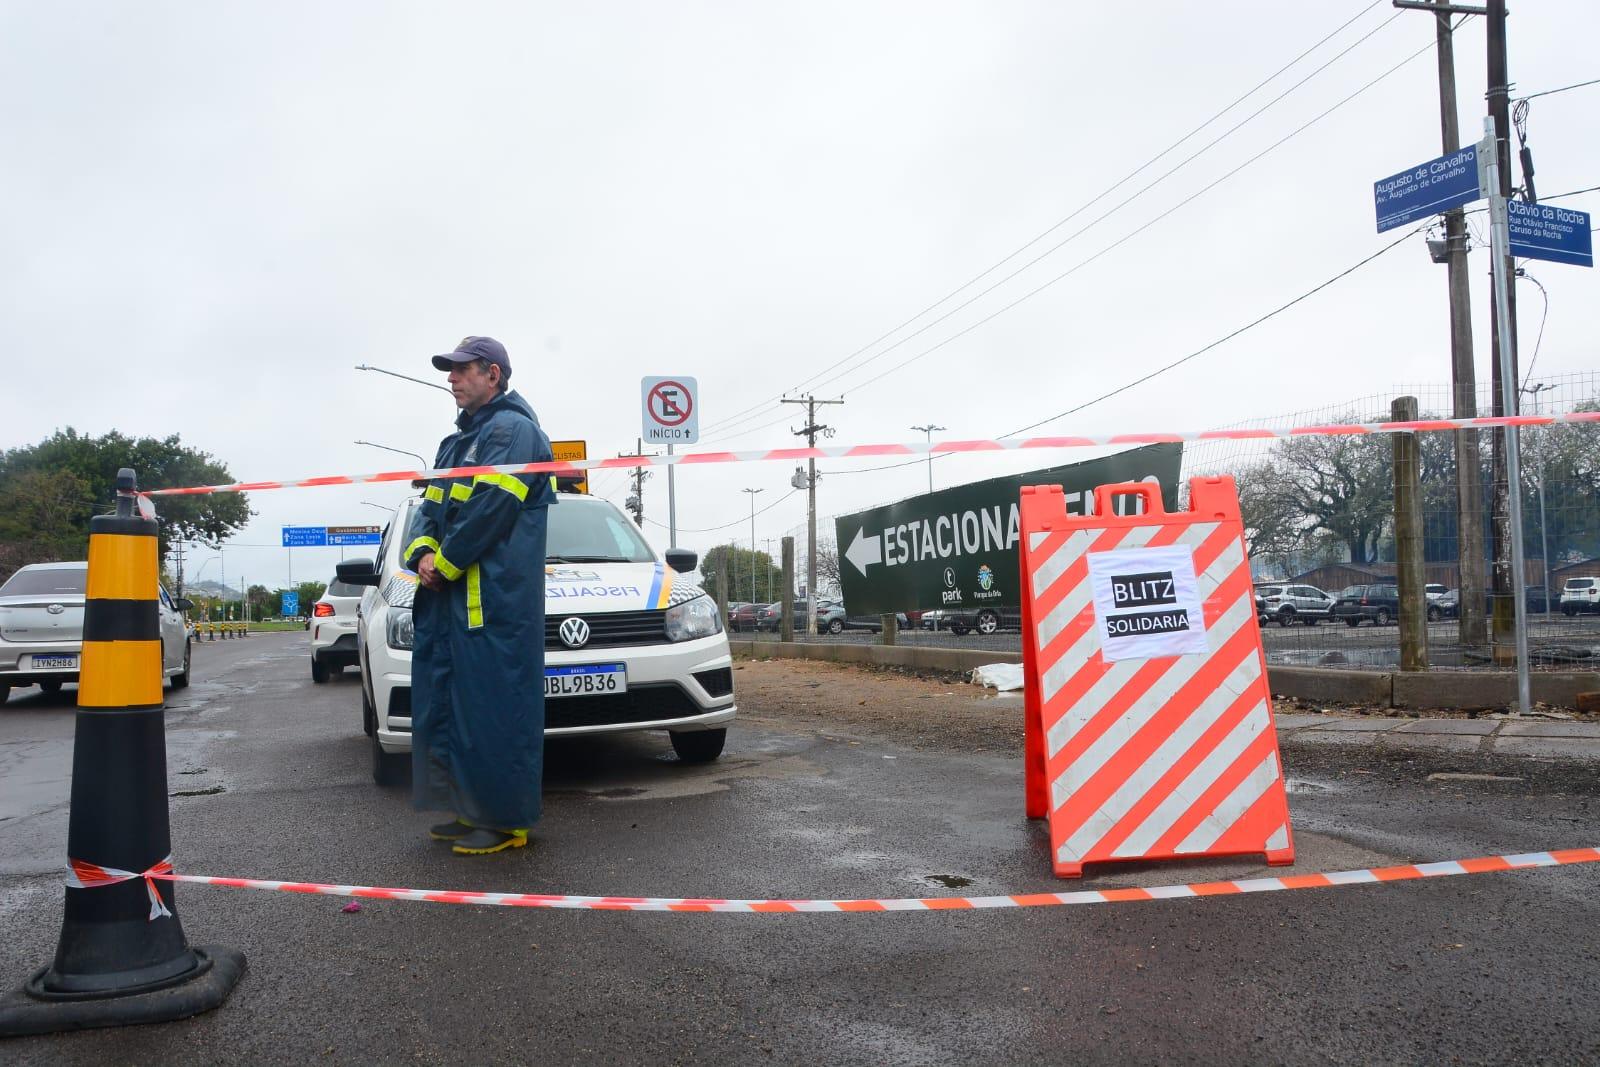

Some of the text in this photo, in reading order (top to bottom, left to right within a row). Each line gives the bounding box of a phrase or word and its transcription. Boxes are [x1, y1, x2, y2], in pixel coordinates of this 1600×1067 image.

[1376, 151, 1474, 195] Augusto de Carvalho
[1377, 166, 1466, 204] Av. Augusto de Carvalho
[1508, 200, 1584, 224] Otávio da Rocha
[1509, 216, 1573, 233] Rua Otávio Francisco
[1509, 225, 1532, 234] Caruso
[1543, 229, 1561, 239] Rocha
[650, 427, 681, 438] INÍCIO
[942, 587, 962, 604] park
[1114, 579, 1175, 602] BLITZ
[1107, 614, 1189, 634] SOLIDARIA
